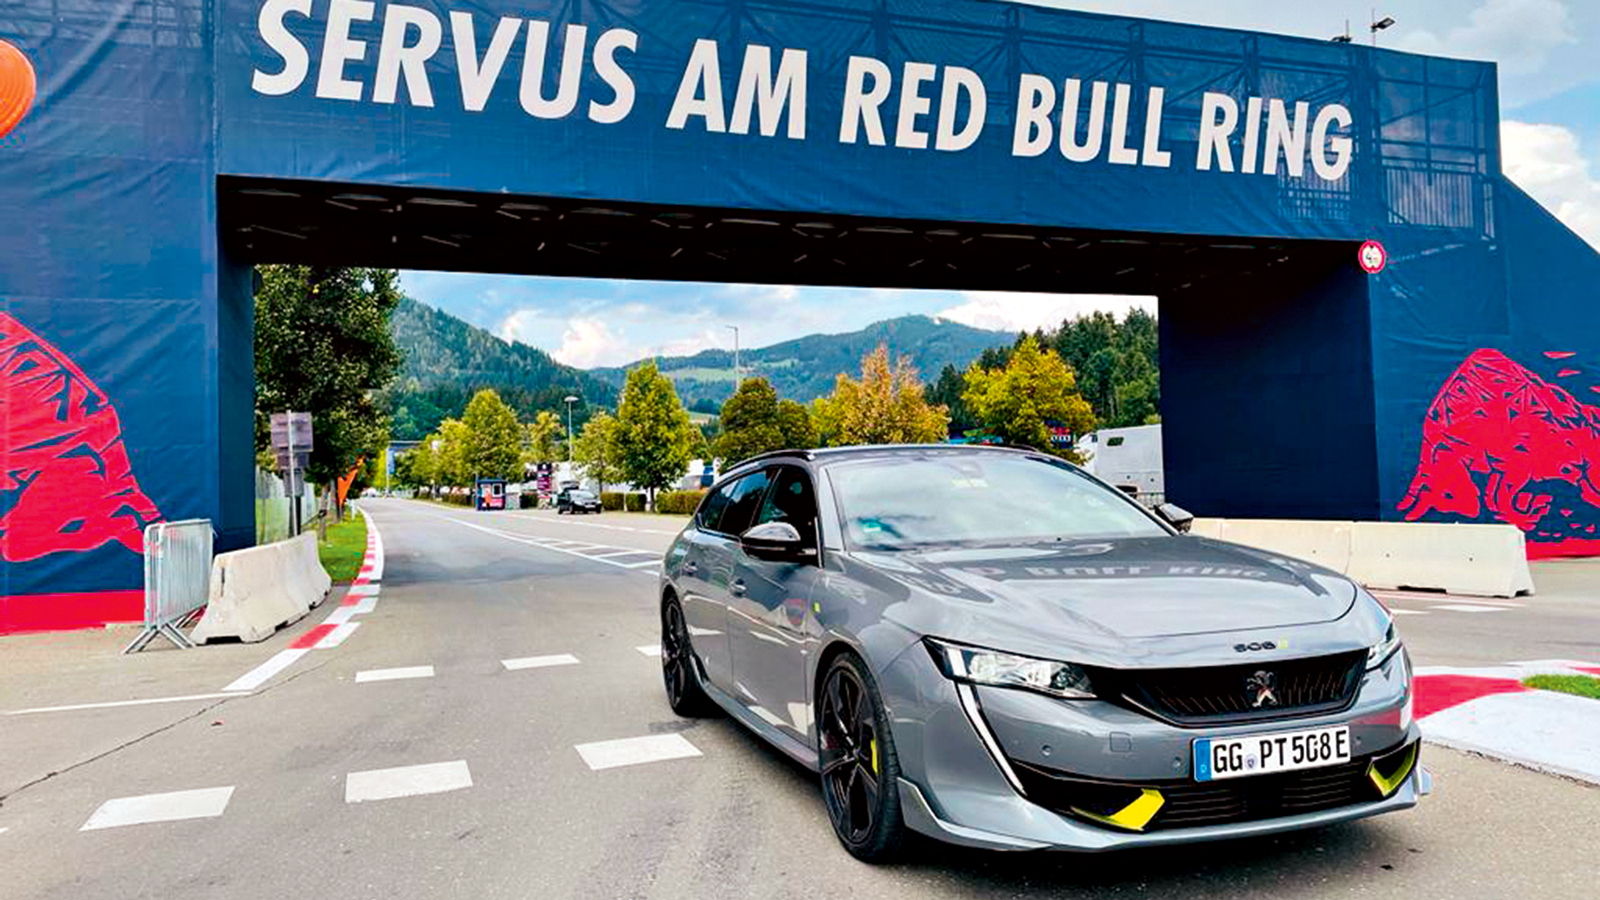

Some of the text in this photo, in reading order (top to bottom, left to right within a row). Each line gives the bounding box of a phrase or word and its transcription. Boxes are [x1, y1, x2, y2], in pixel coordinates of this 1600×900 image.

[251, 0, 1353, 181] SERVUS AM RED BULL RING
[1213, 743, 1242, 773] GG
[1259, 737, 1287, 768] PT
